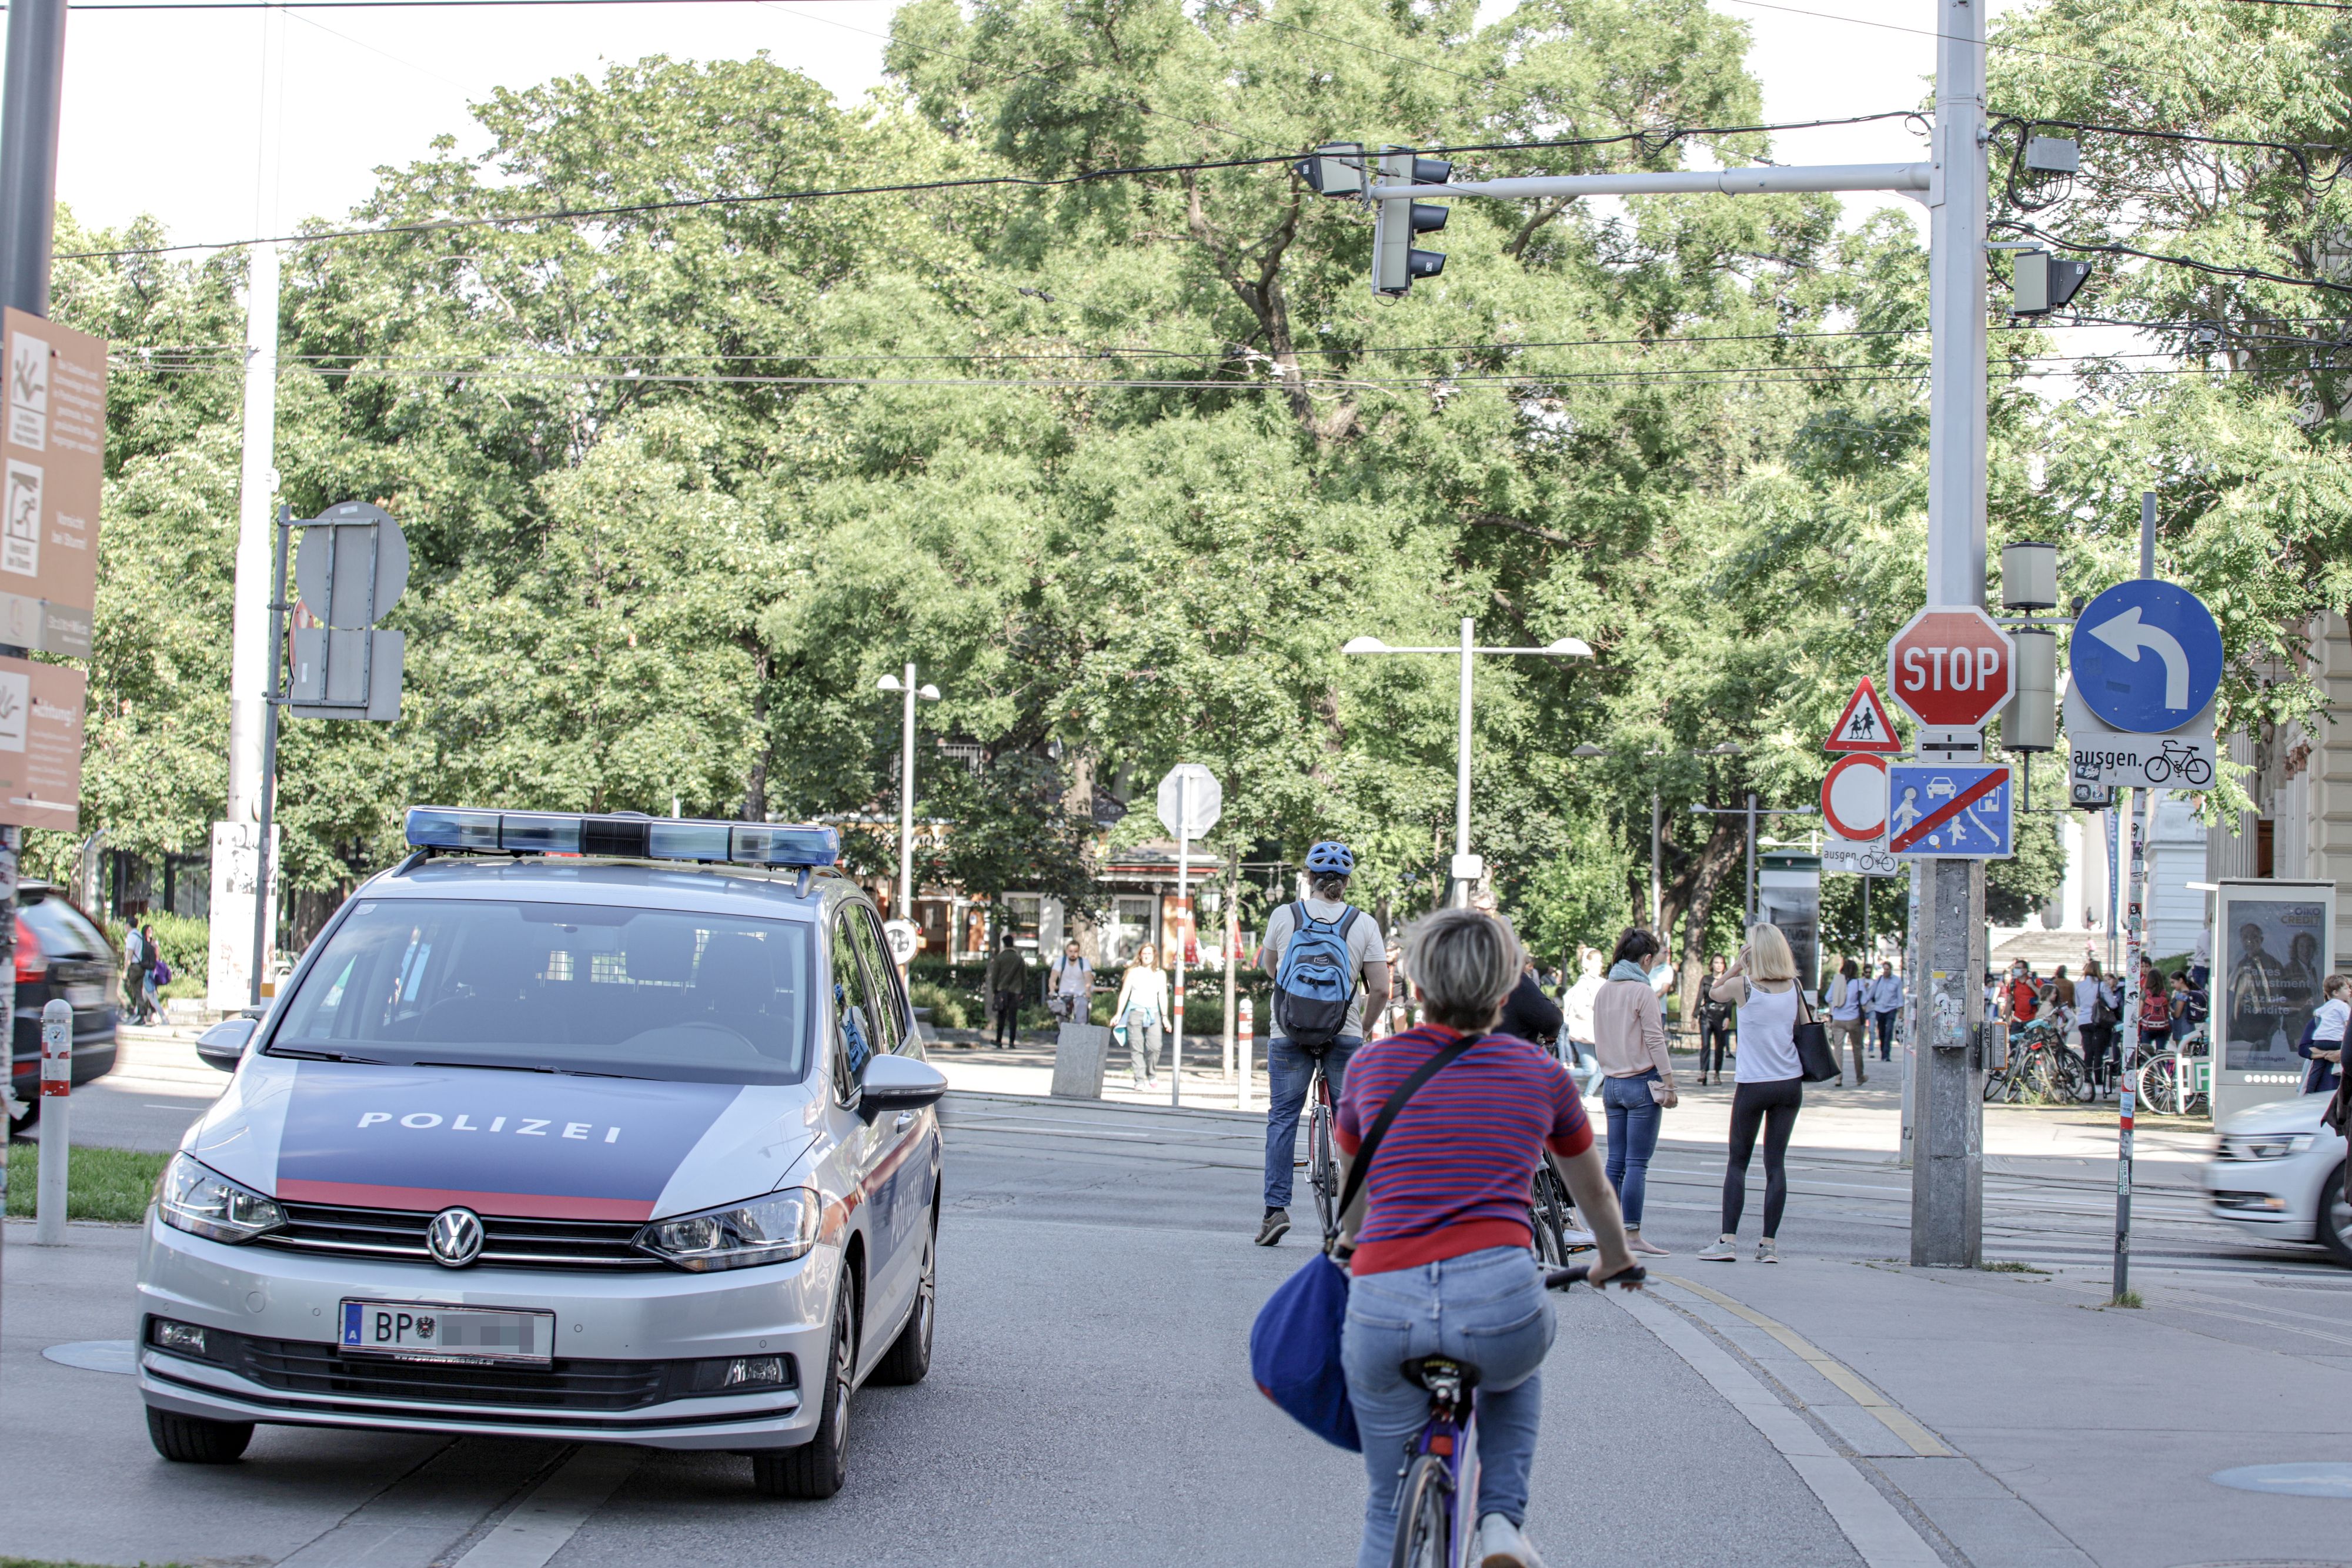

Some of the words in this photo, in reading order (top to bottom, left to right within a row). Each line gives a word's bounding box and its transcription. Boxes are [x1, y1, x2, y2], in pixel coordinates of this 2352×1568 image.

[2077, 265, 2083, 273] 7
[1903, 647, 1999, 691] STOP
[2074, 750, 2142, 770] ausgen.
[1824, 850, 1859, 862] ausgen.
[2294, 907, 2321, 916] OIKO
[2281, 915, 2321, 924] CREDIT
[2243, 967, 2281, 976] ares
[2243, 978, 2311, 988] nvstment
[2243, 1005, 2290, 1015] Rendite
[356, 1112, 622, 1144] POLIZEI
[890, 1171, 920, 1252] POLIZEI
[376, 1312, 413, 1343] BP
[349, 1330, 358, 1339] A
